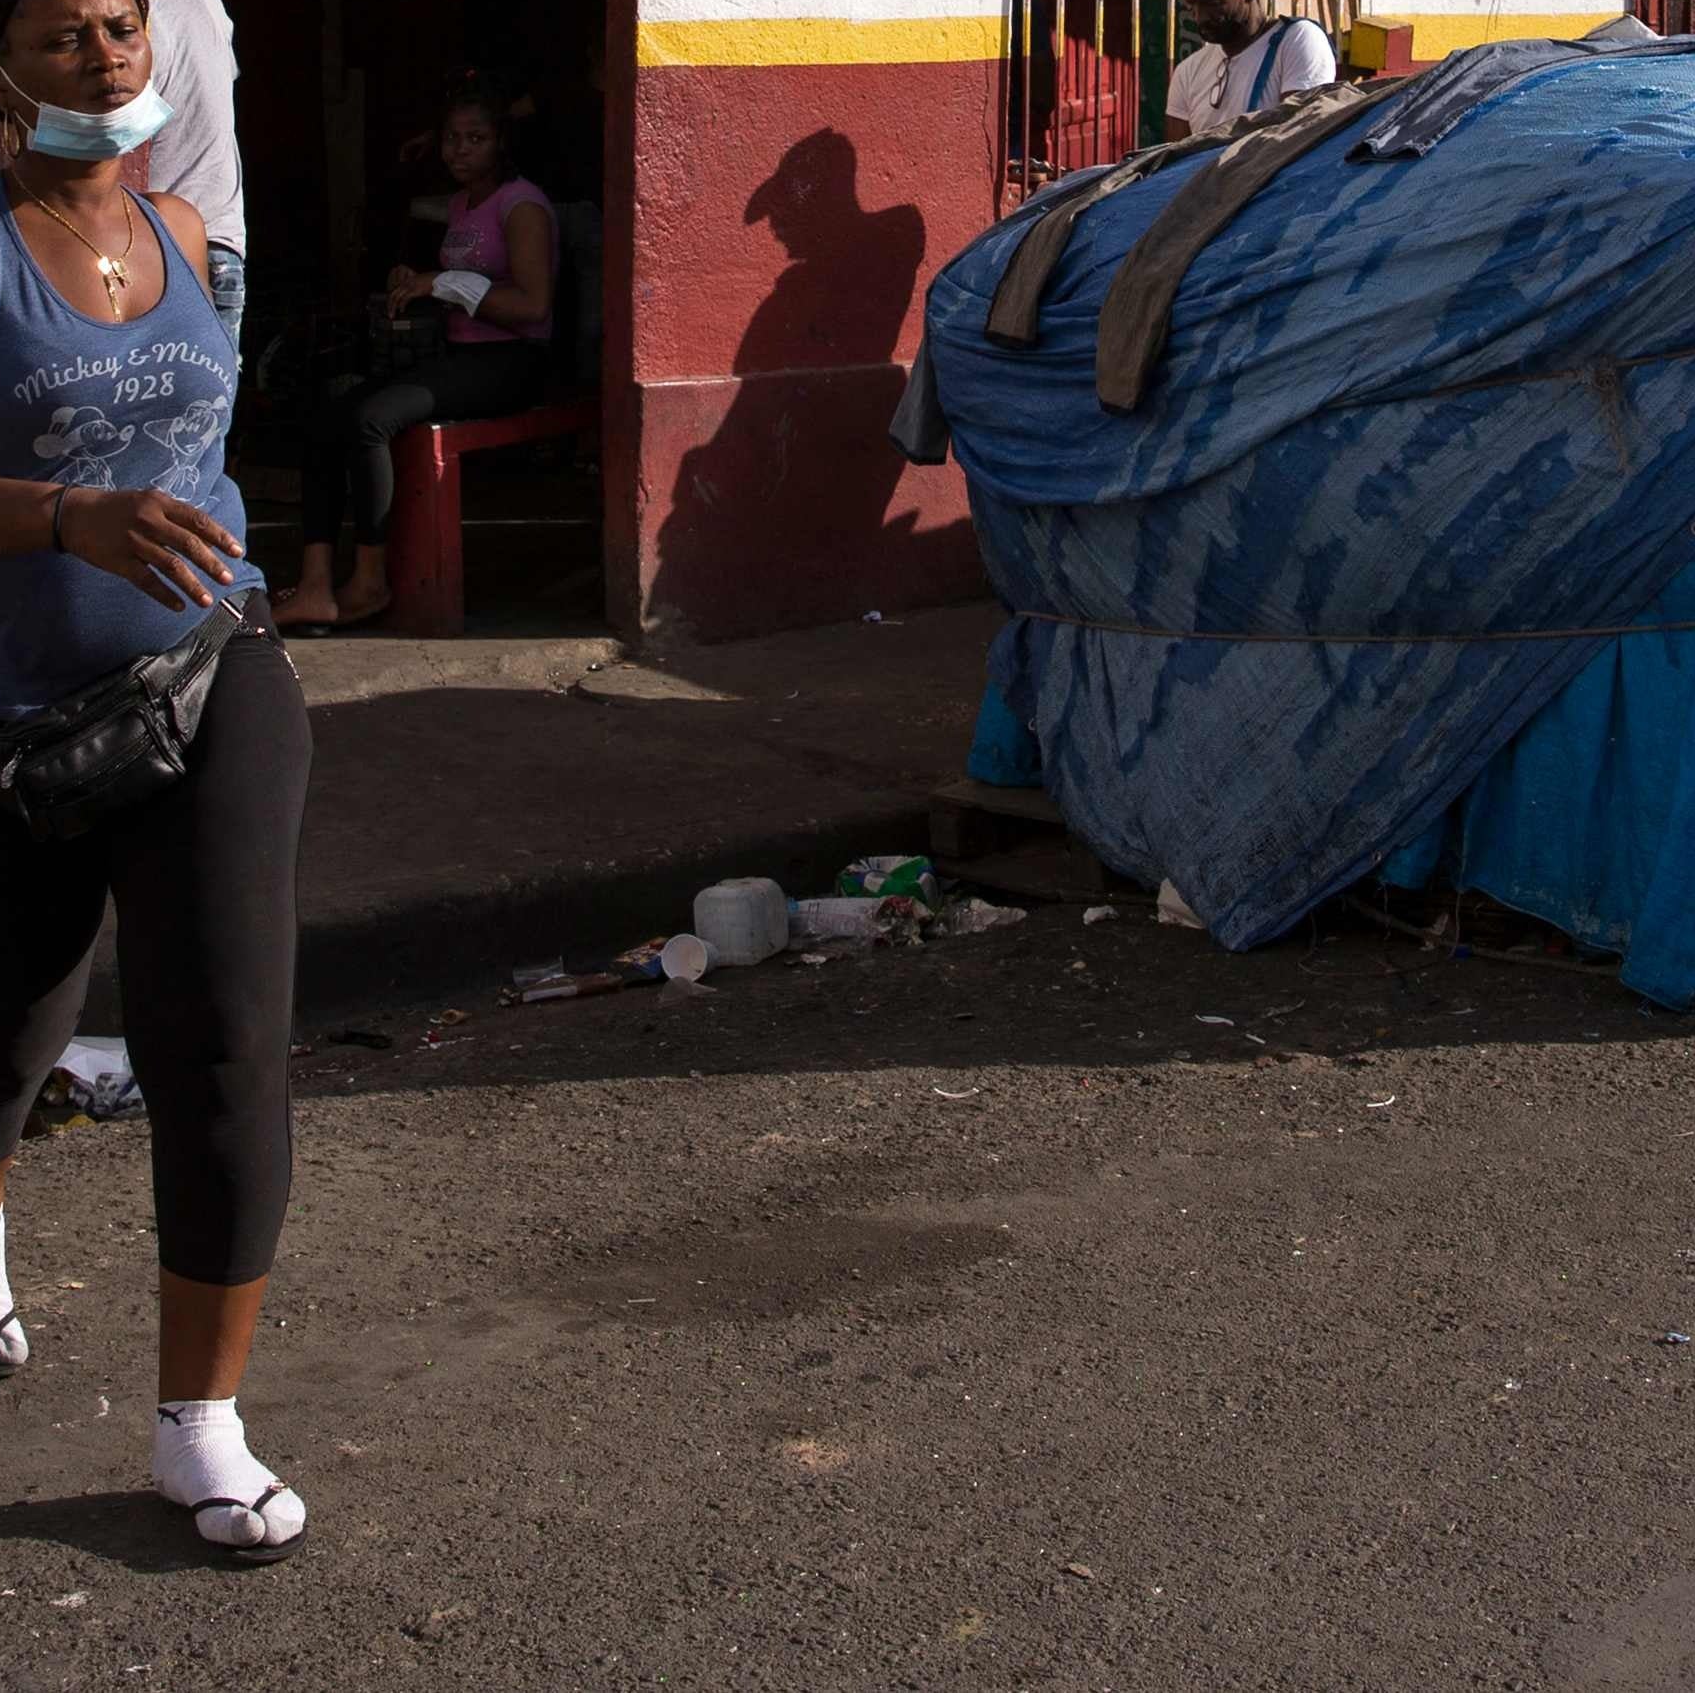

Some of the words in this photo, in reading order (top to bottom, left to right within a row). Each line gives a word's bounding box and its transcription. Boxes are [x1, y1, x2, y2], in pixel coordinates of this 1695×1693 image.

[14, 355, 123, 405] Mickey
[128, 347, 151, 366] &
[113, 371, 176, 404] 1928
